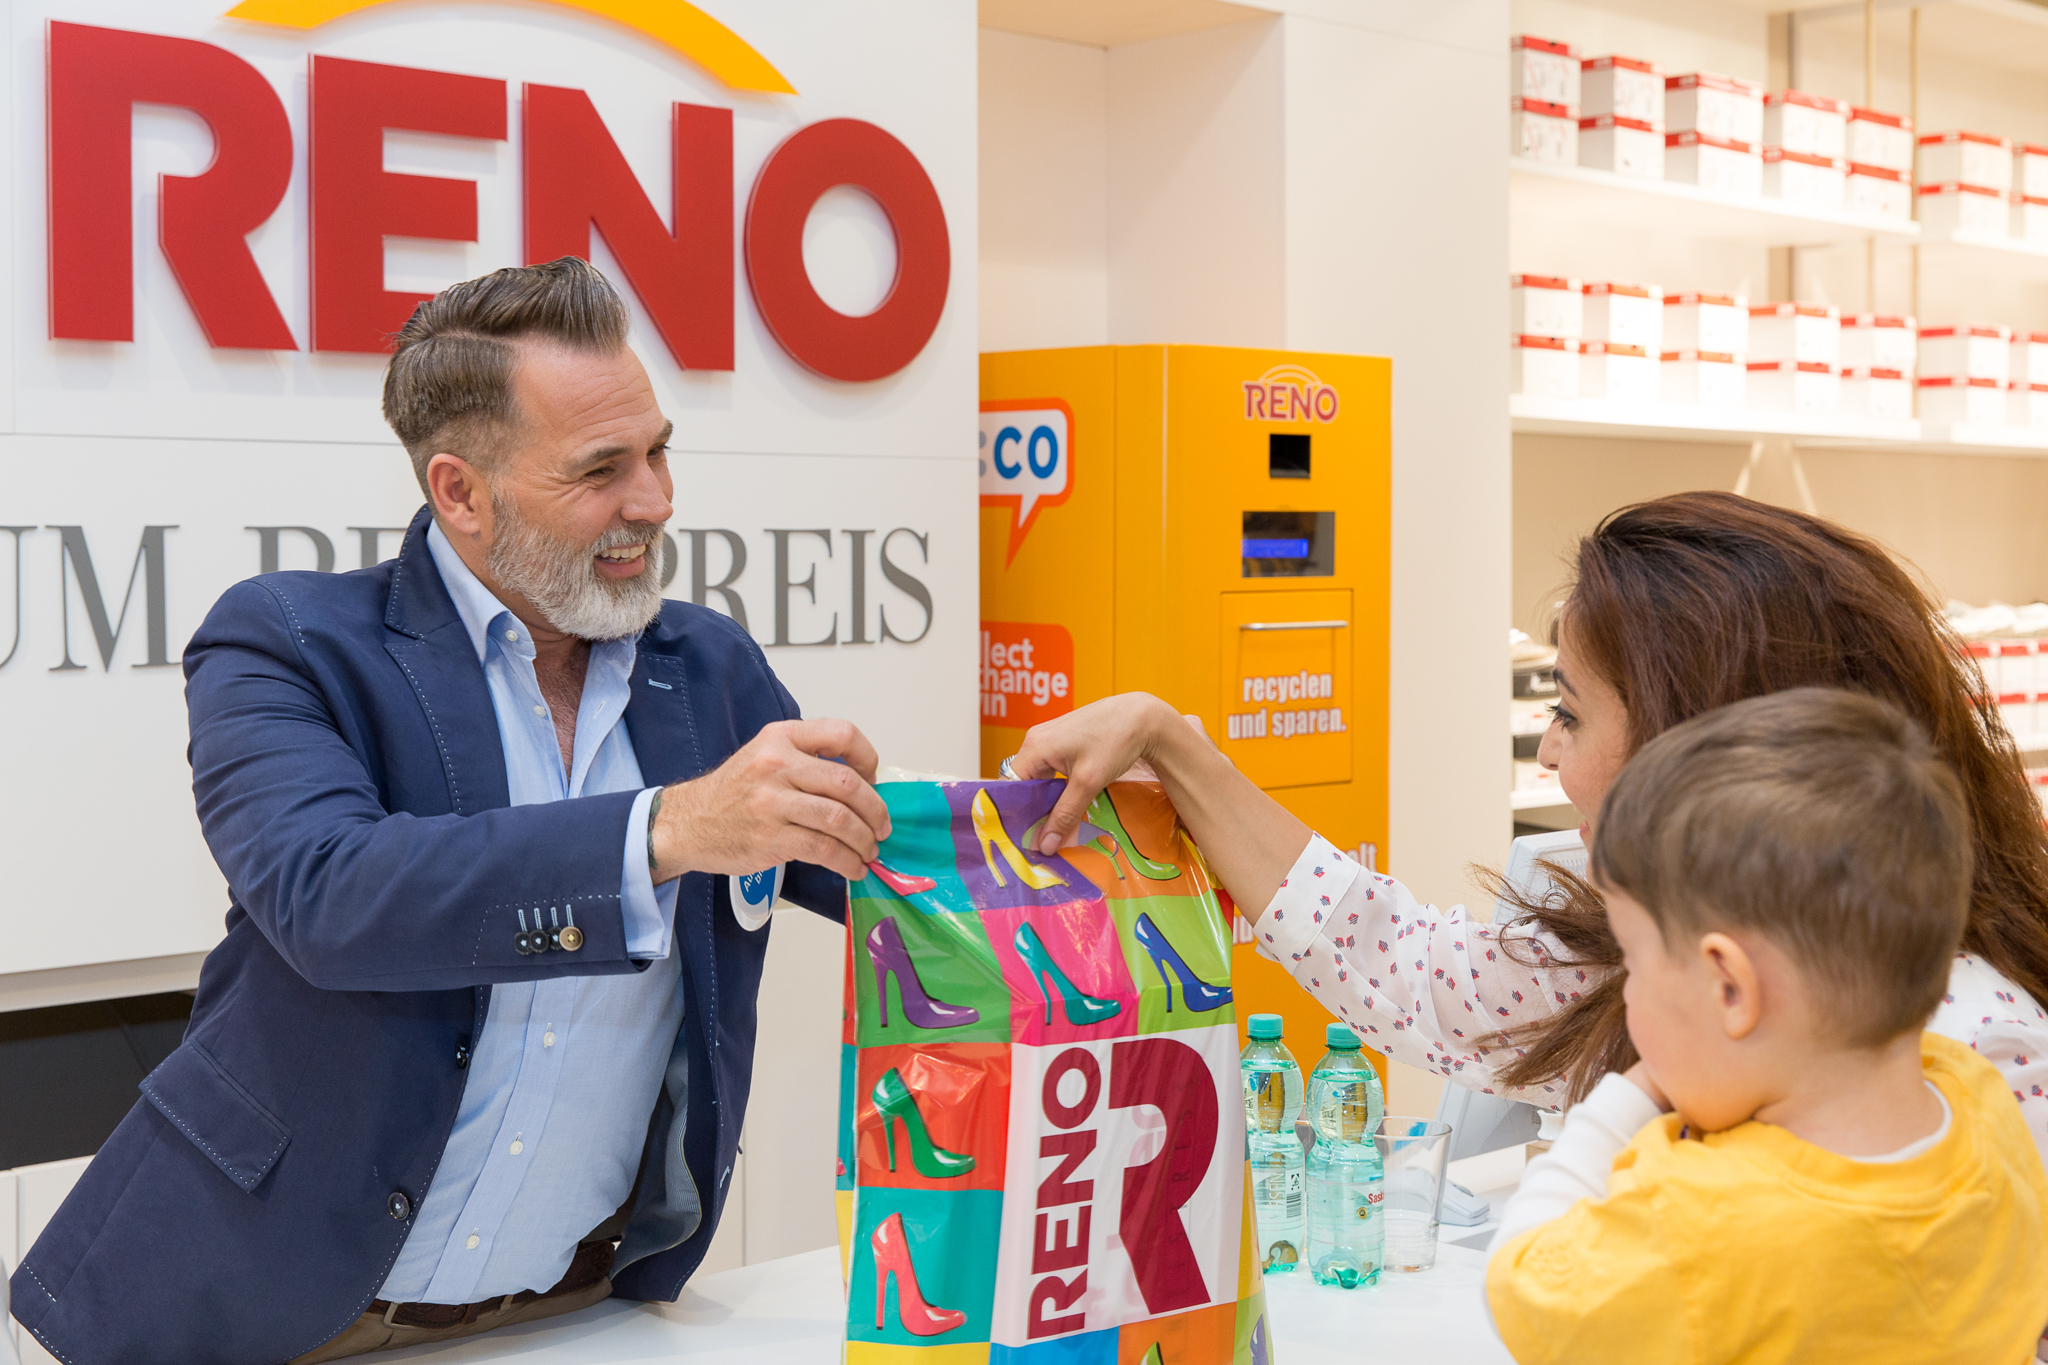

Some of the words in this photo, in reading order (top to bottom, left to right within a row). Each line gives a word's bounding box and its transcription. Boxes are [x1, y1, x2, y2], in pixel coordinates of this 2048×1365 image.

[47, 19, 951, 383] RENO
[1243, 381, 1339, 424] RENO
[980, 663, 1069, 706] hange
[1243, 670, 1332, 704] recyclen
[1228, 707, 1268, 740] und
[1271, 707, 1347, 739] sparen.
[1027, 1047, 1101, 1340] RENO
